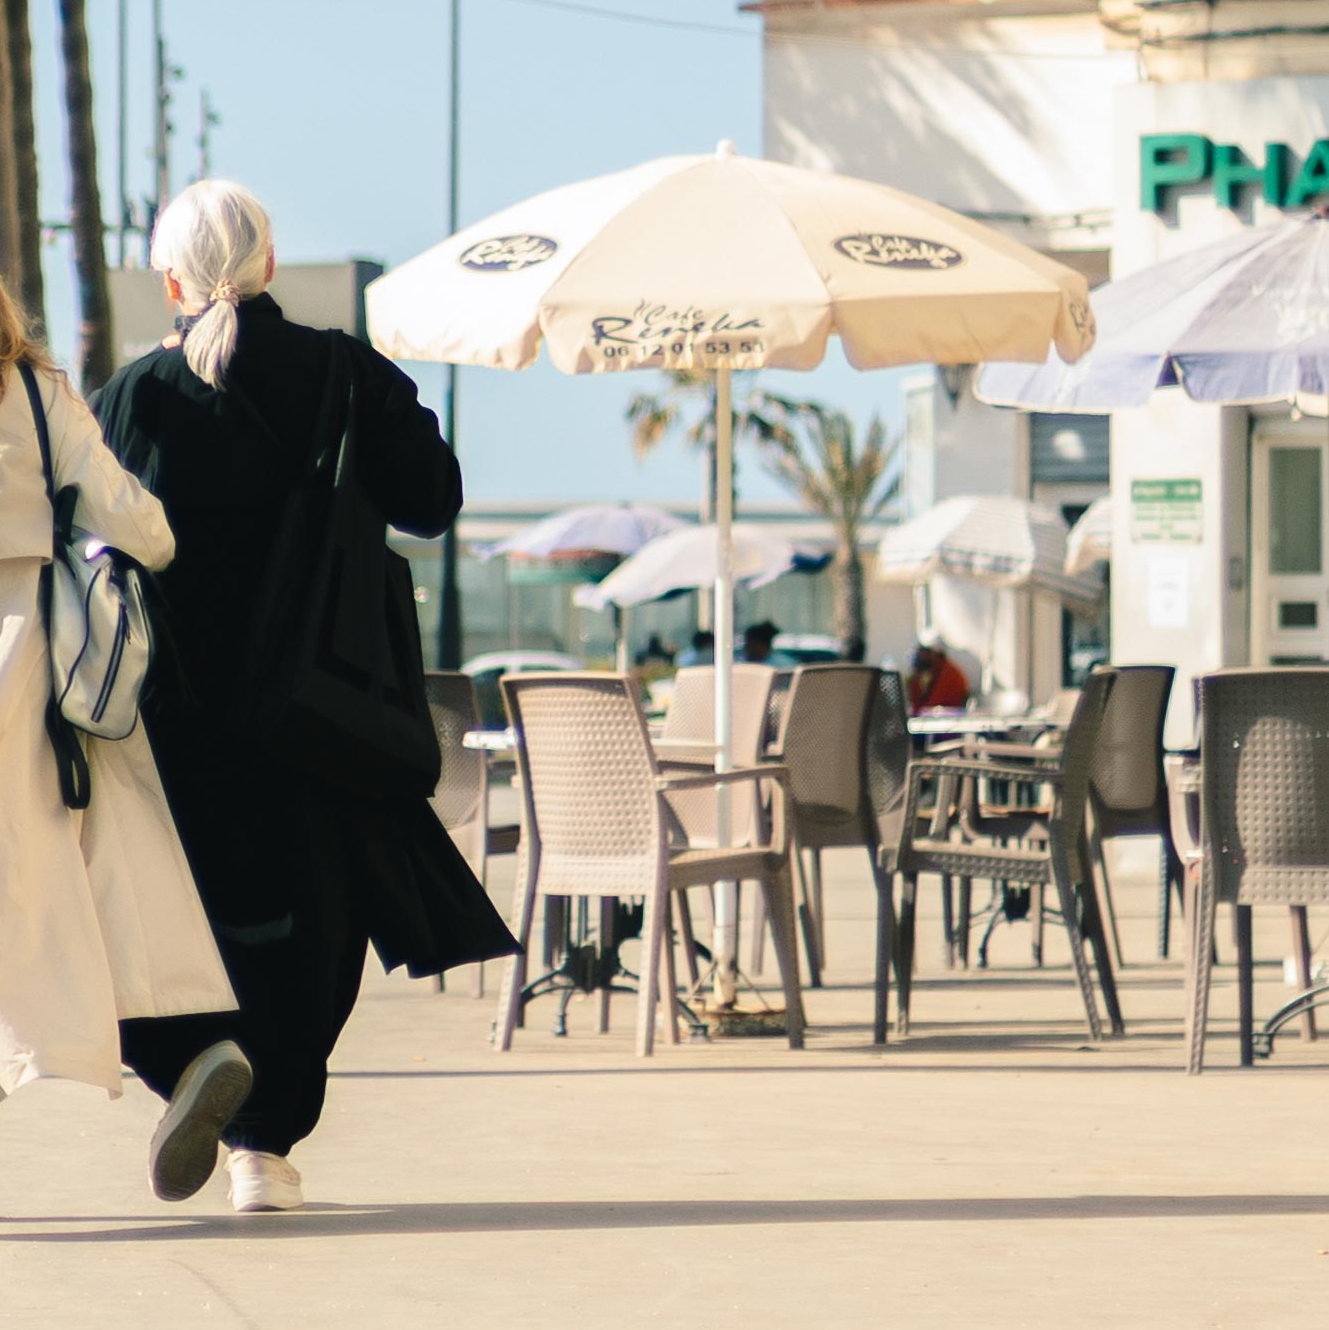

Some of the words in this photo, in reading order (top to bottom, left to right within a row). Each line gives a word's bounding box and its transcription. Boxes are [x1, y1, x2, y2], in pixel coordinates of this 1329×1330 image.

[1138, 133, 1329, 210] PHA
[603, 345, 630, 358] 06
[705, 342, 730, 354] 53
